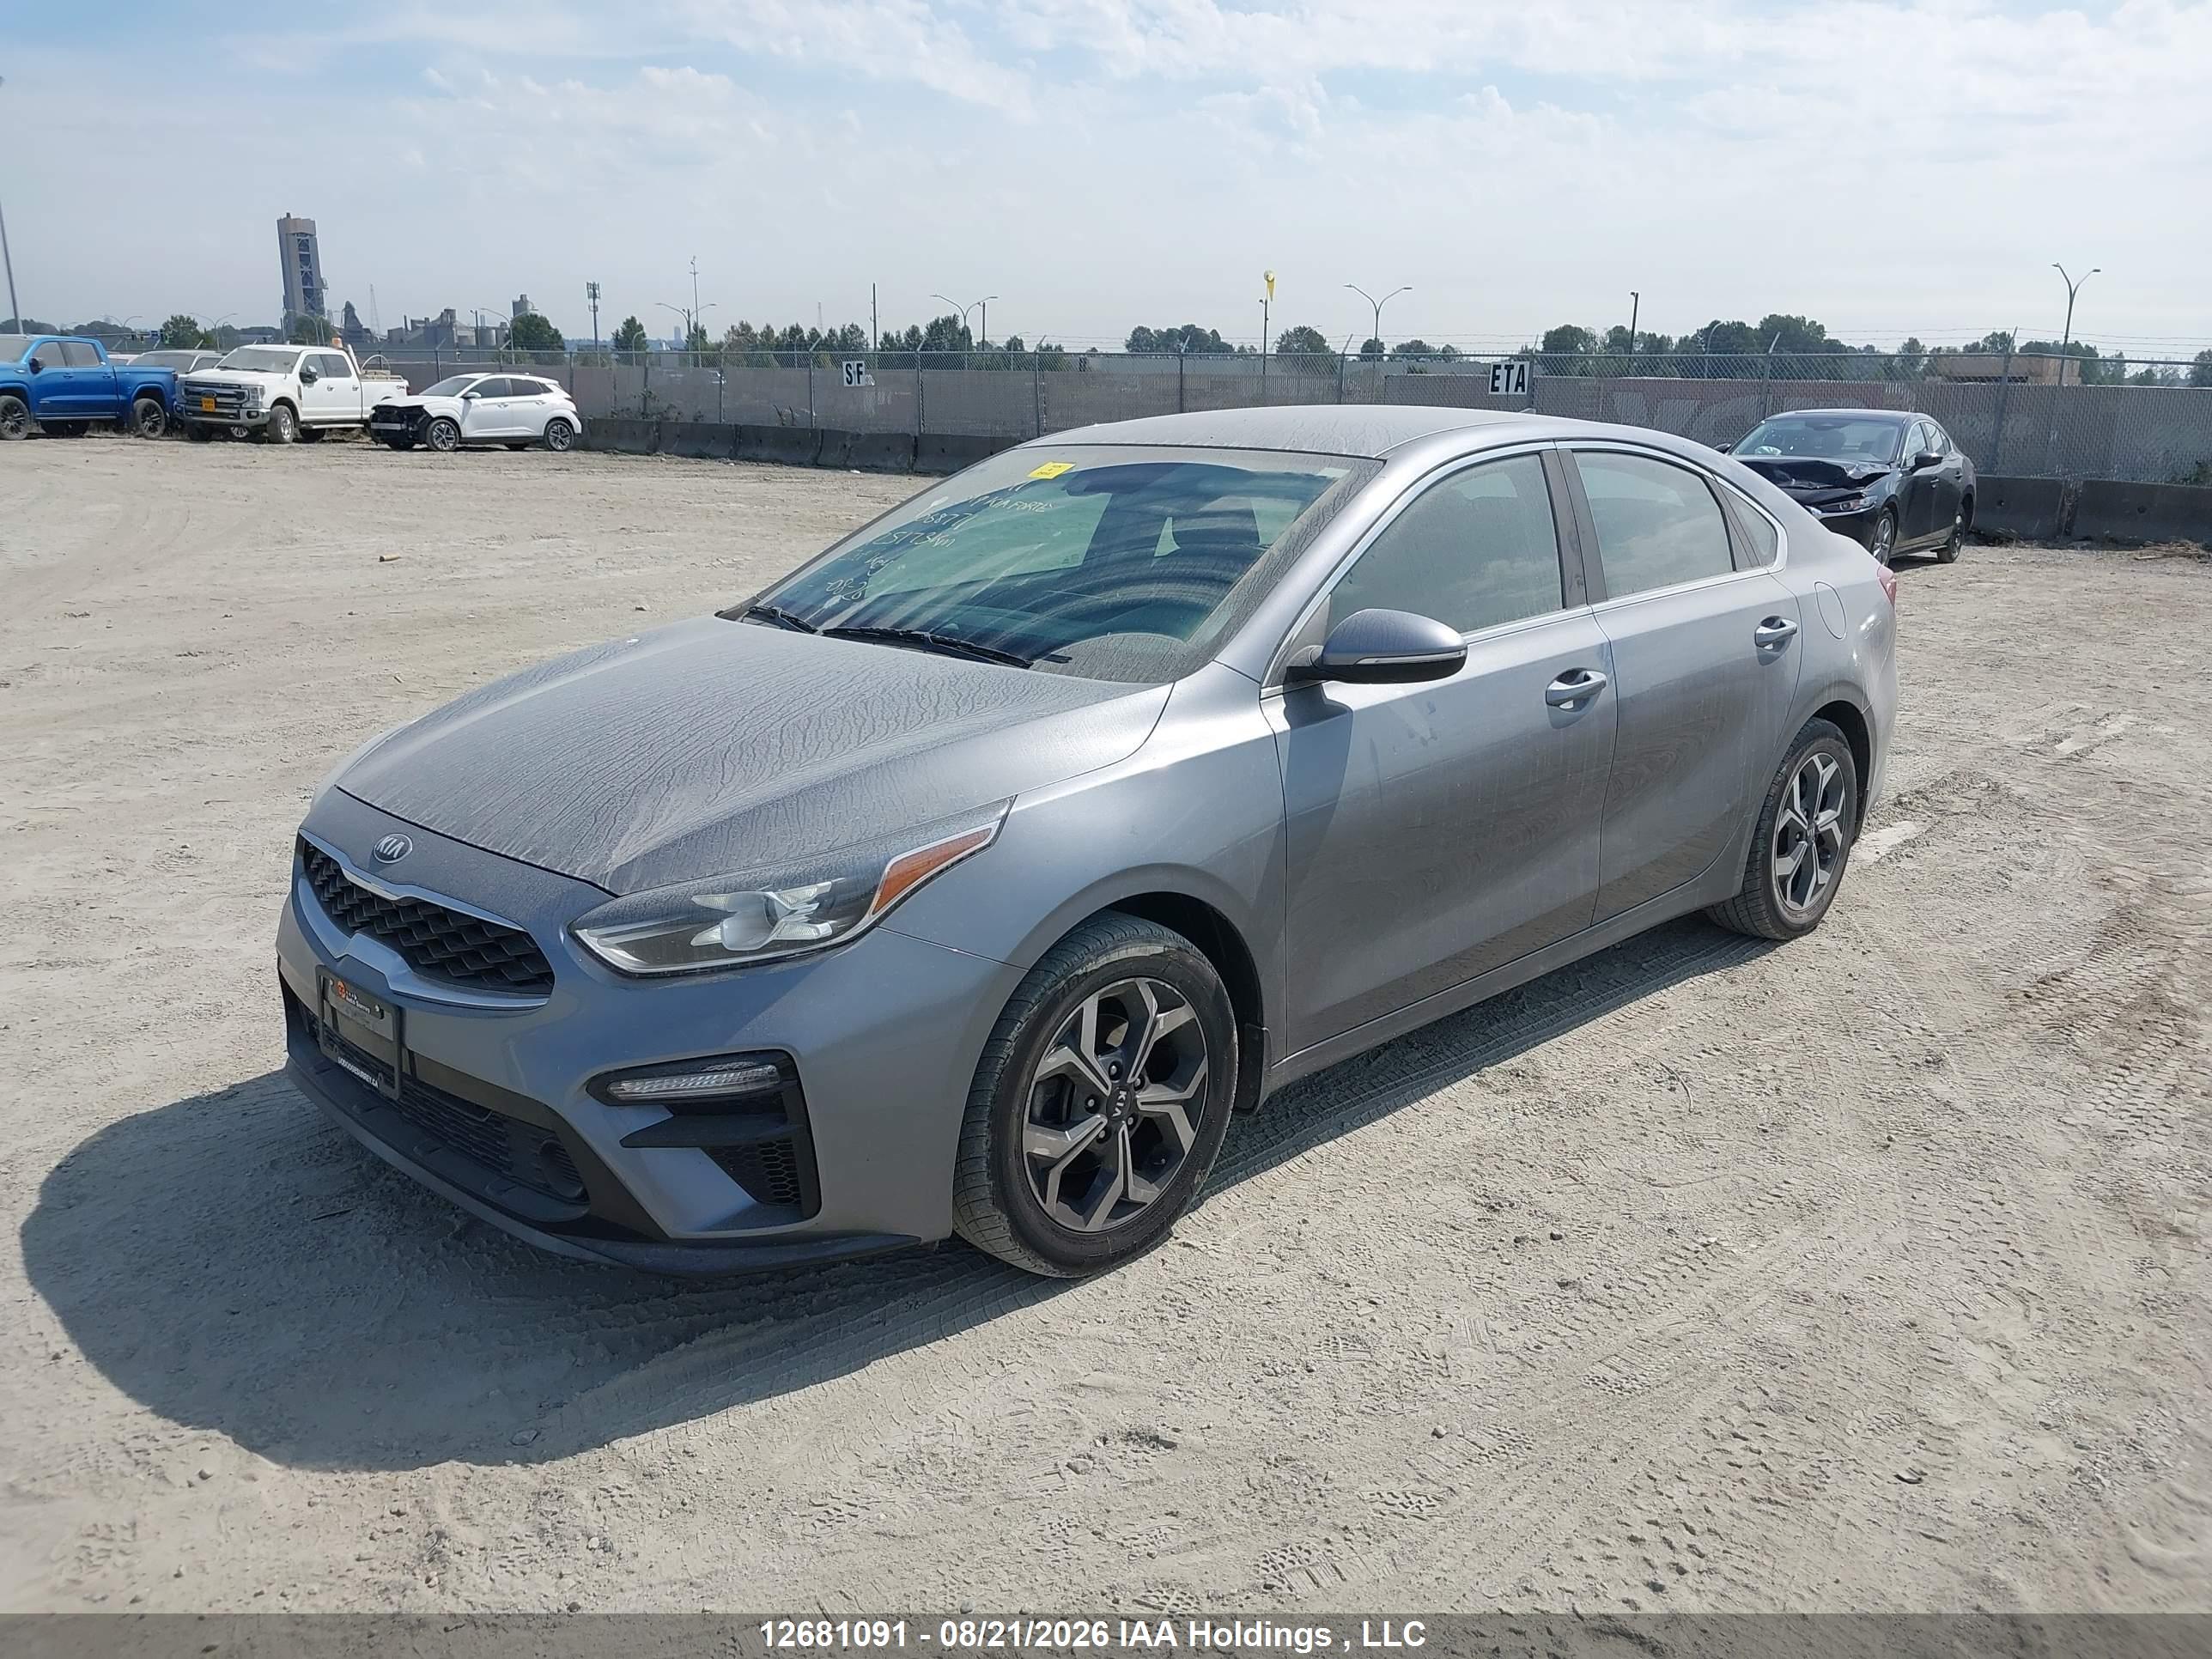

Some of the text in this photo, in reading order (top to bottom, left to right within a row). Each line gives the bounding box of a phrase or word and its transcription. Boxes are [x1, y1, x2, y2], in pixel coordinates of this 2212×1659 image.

[845, 362, 863, 386] SF
[1490, 363, 1526, 392] ETA
[376, 836, 405, 859] KIA
[1111, 1091, 1127, 1117] KIA
